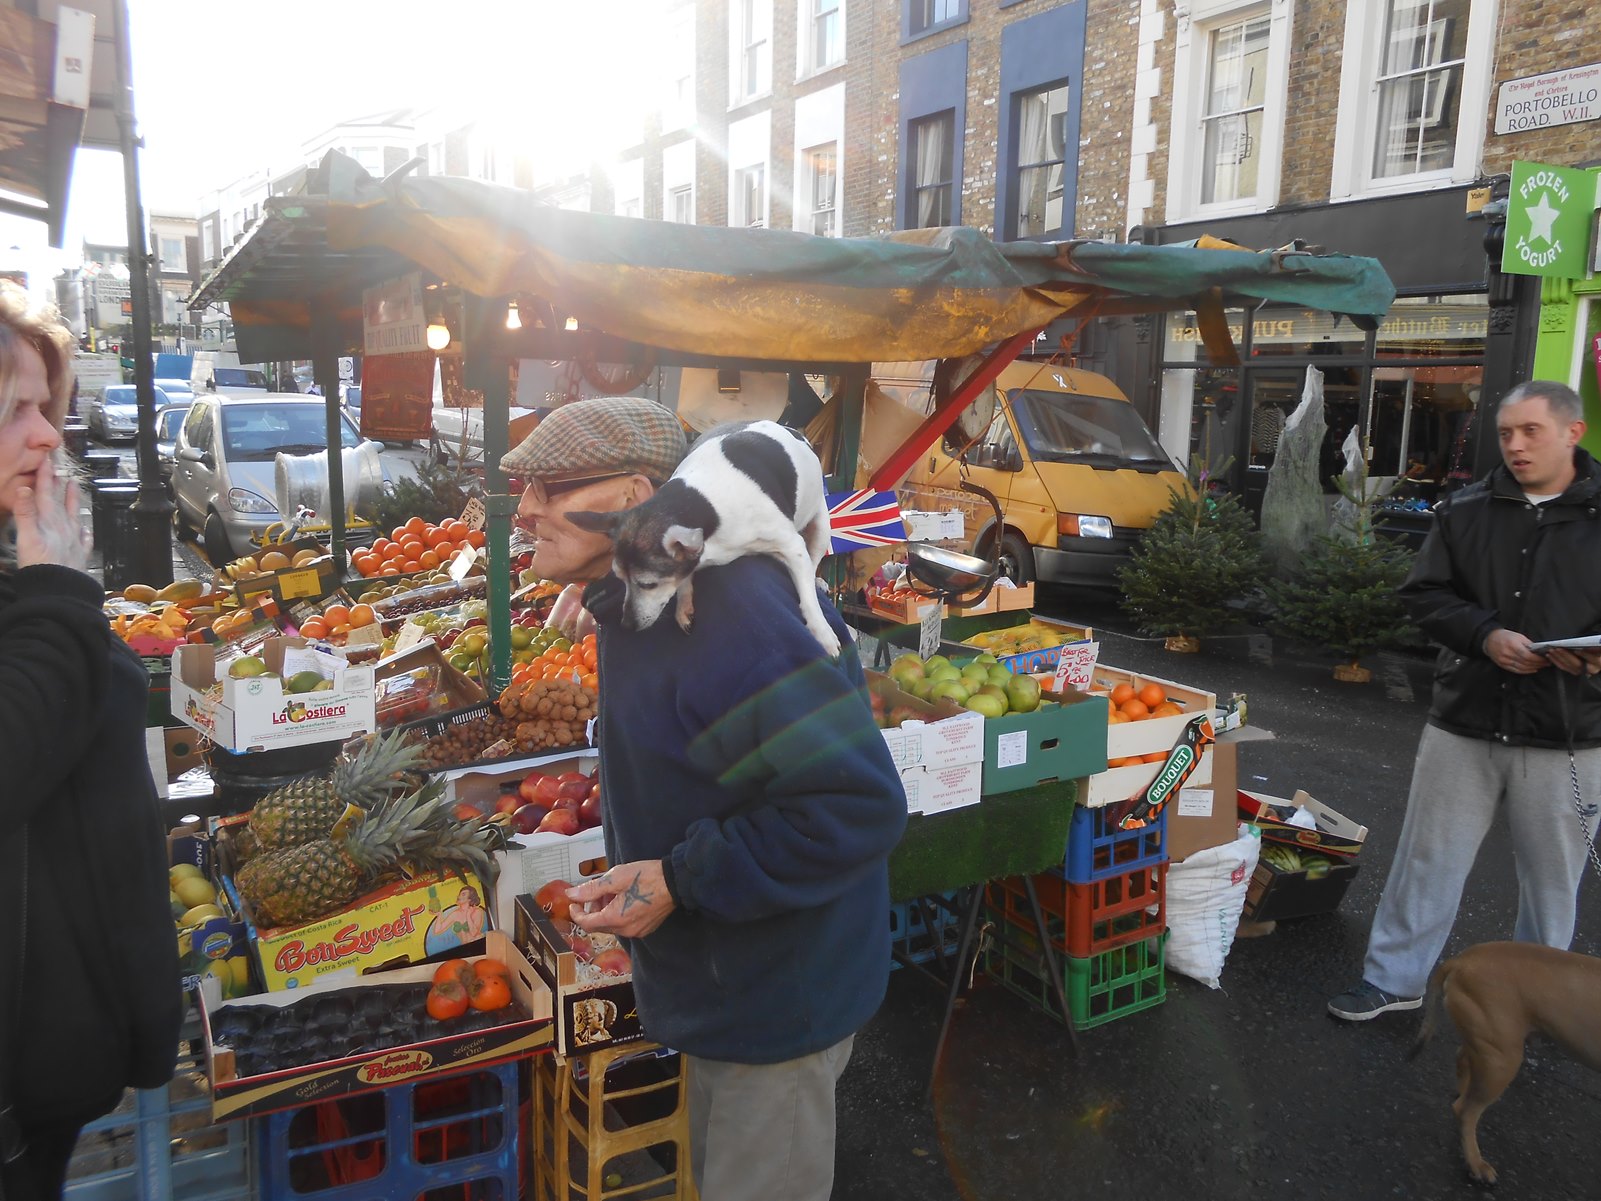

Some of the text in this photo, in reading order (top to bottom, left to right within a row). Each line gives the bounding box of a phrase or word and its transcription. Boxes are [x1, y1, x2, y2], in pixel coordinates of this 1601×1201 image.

[1505, 88, 1598, 117] PORTOBELLO
[1519, 171, 1570, 204] FROZEN
[1515, 235, 1563, 268] YOGURT
[1151, 750, 1189, 800] BOUQUET
[369, 902, 389, 912] CAT-1
[316, 956, 361, 974] Extra Sweet
[295, 1079, 320, 1098] Gold
